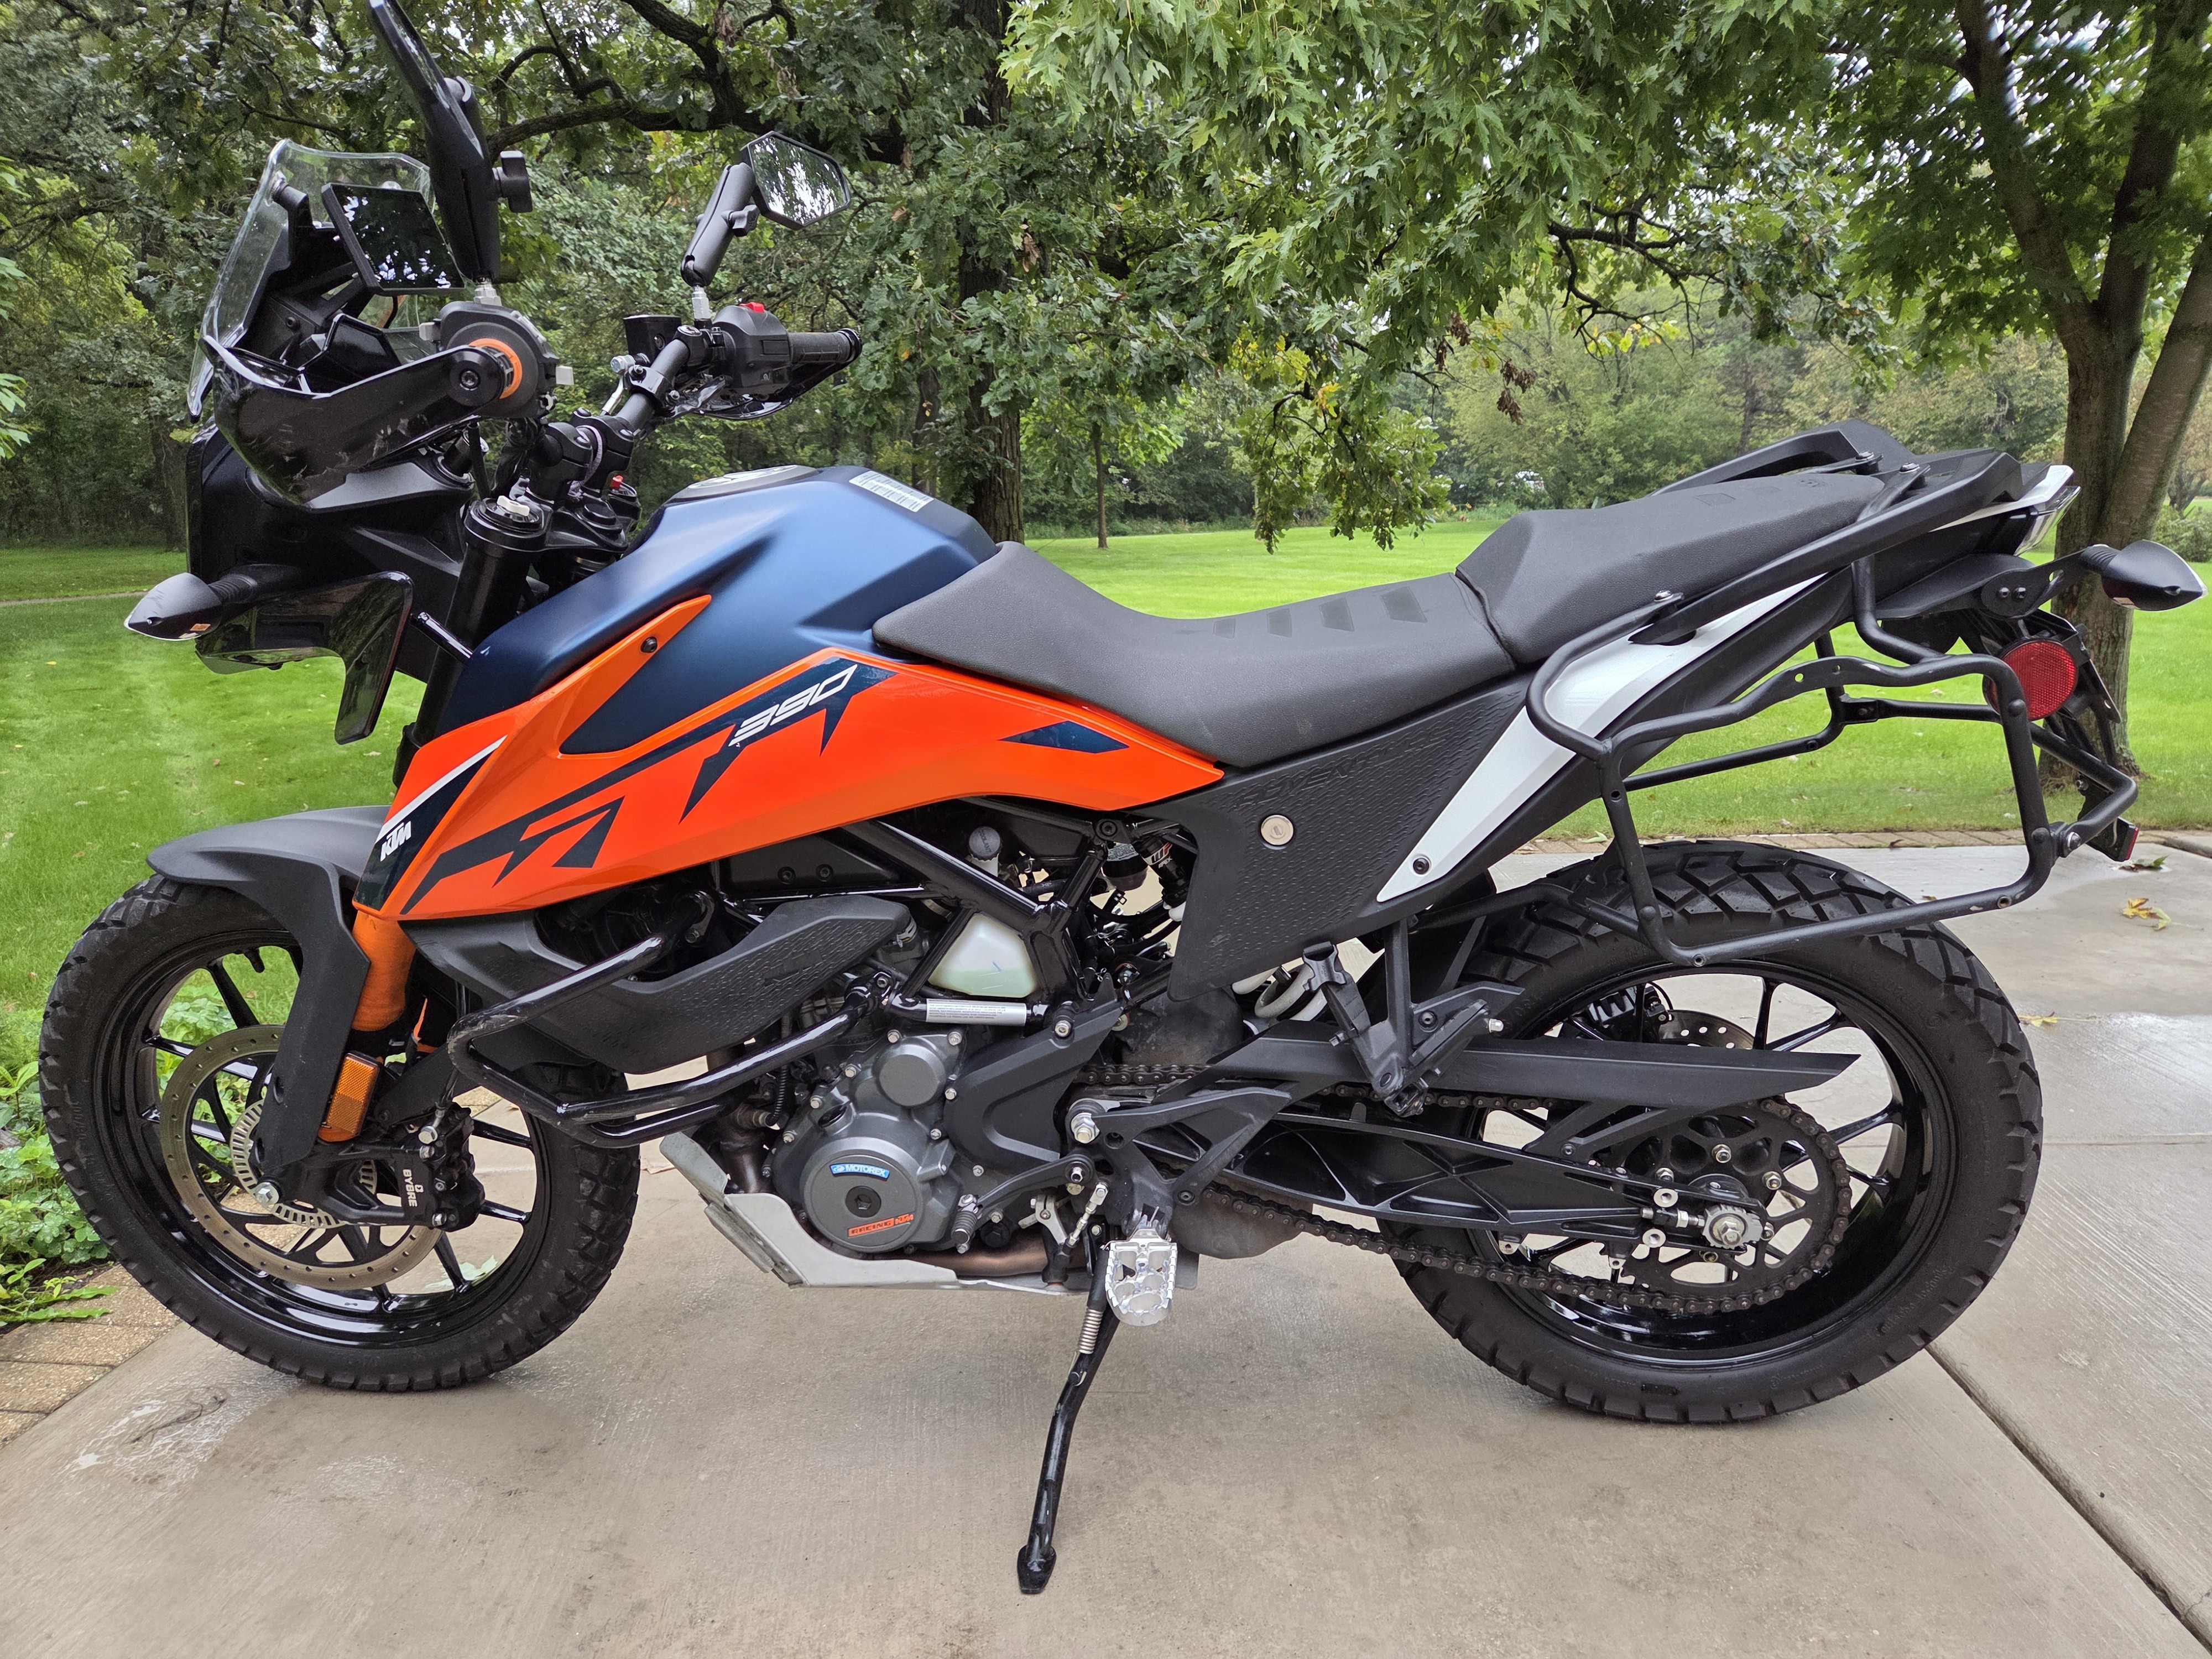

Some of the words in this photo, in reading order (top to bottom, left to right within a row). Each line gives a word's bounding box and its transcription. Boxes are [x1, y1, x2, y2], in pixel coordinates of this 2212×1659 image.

[728, 664, 858, 747] 390
[380, 821, 411, 862] KTM
[975, 829, 992, 853] COOLANT
[1159, 856, 1173, 869] APEX
[846, 1164, 887, 1178] MOTOREX
[403, 1169, 418, 1207] BYBRE
[851, 1220, 892, 1235] RACING
[895, 1214, 914, 1225] KTM
